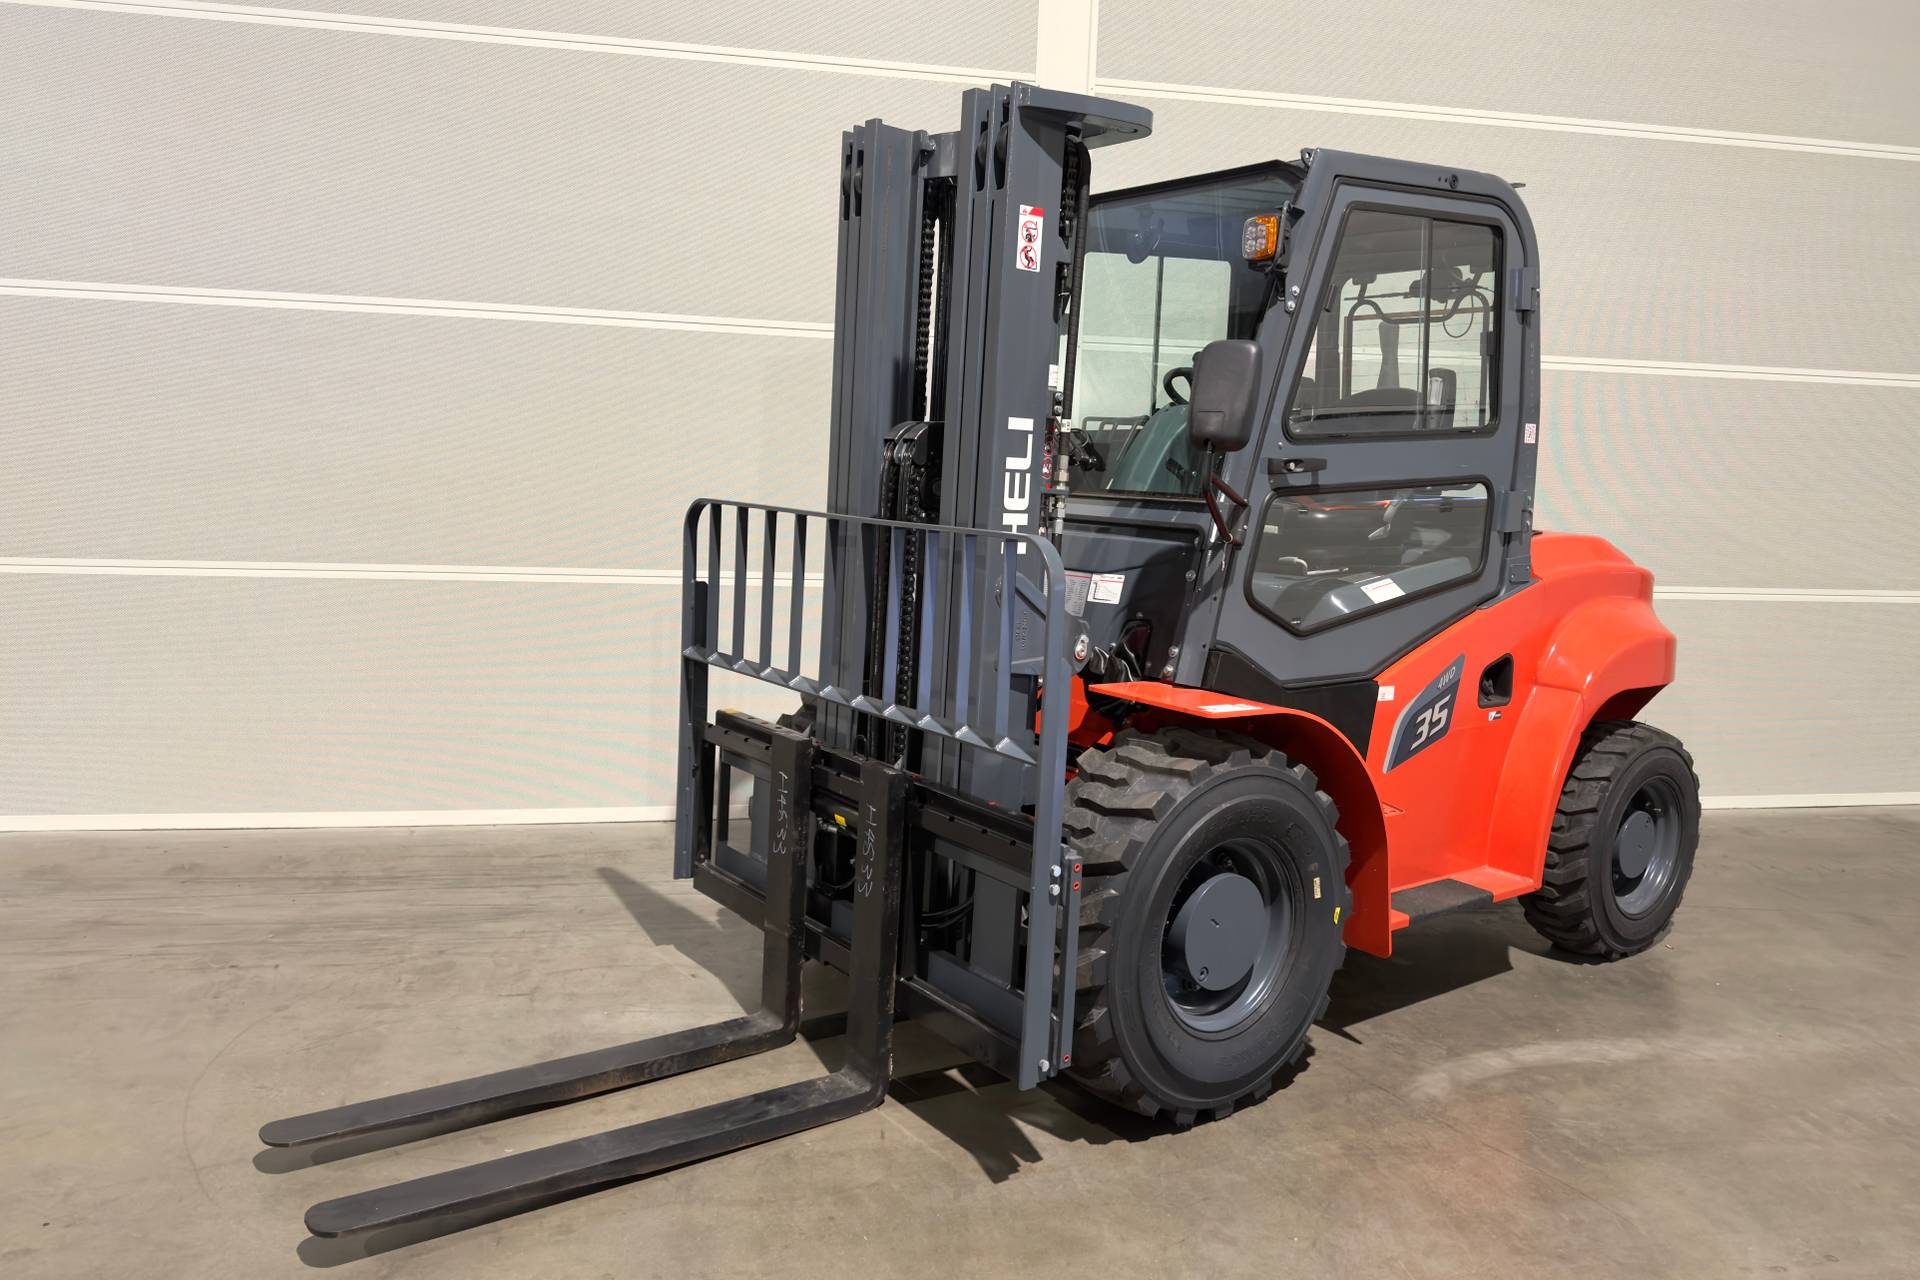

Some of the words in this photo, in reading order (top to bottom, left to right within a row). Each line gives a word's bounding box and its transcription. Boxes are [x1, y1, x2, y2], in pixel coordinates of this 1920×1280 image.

[1001, 417, 1034, 554] HELI
[1438, 666, 1456, 689] 4WD
[1410, 694, 1451, 751] 35
